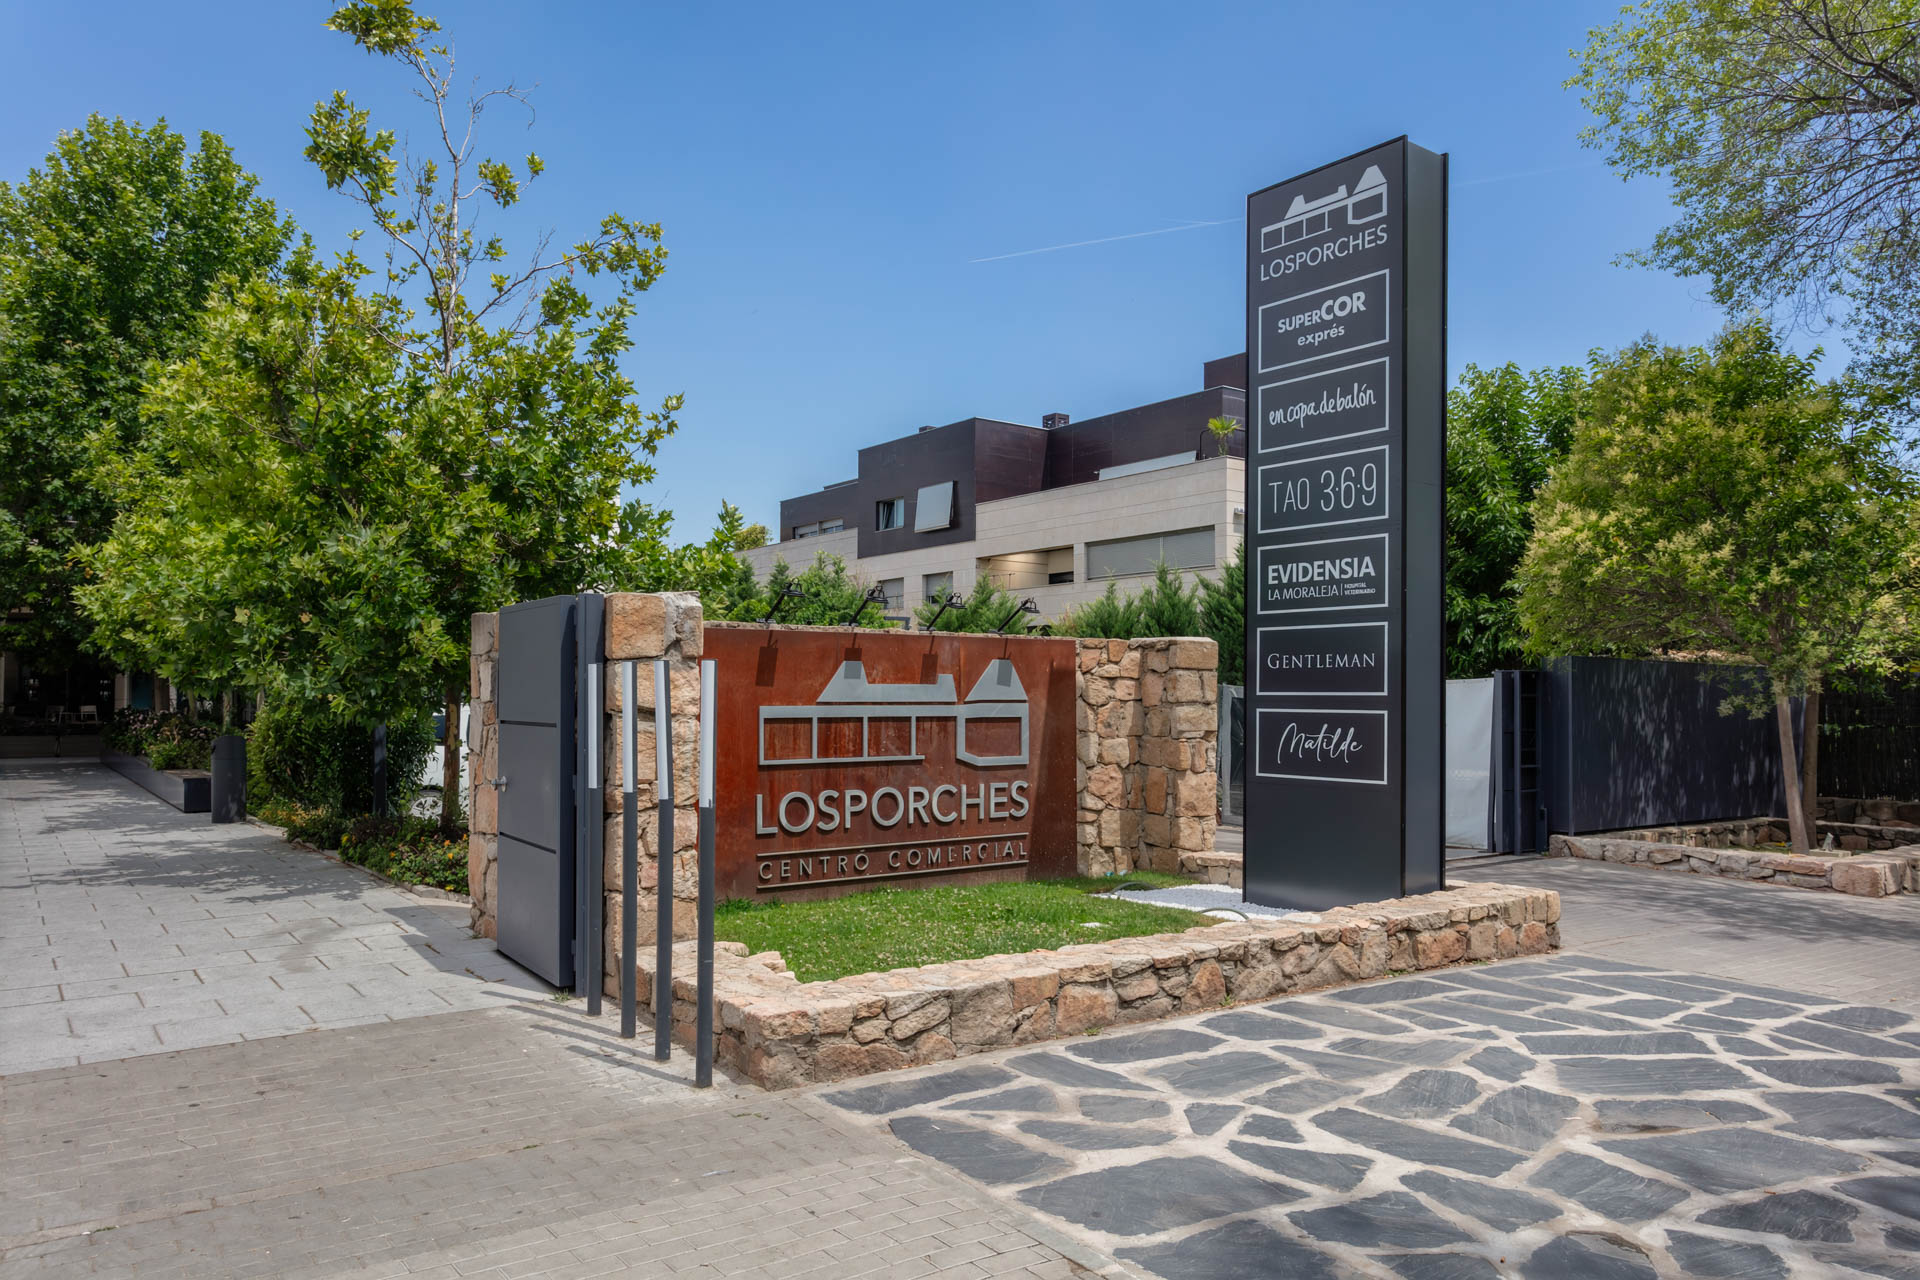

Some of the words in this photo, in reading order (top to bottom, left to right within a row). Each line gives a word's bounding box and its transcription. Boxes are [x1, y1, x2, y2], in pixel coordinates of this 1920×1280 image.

[1260, 224, 1388, 282] LOSPORCHES
[1278, 291, 1367, 333] SUPERCOR
[1297, 323, 1345, 346] exprés
[1269, 408, 1287, 425] en
[1287, 402, 1319, 428] copa
[1336, 382, 1376, 411] balón
[1268, 478, 1310, 514] TAO
[1267, 556, 1376, 585] EVIDENSIA
[1268, 589, 1281, 601] LA
[1282, 584, 1339, 600] MORALEJA
[1277, 722, 1363, 764] Matilde
[756, 780, 1030, 835] LOSPORCHES
[759, 852, 870, 880] CENTRO
[888, 841, 1028, 868] COMERCIAL
